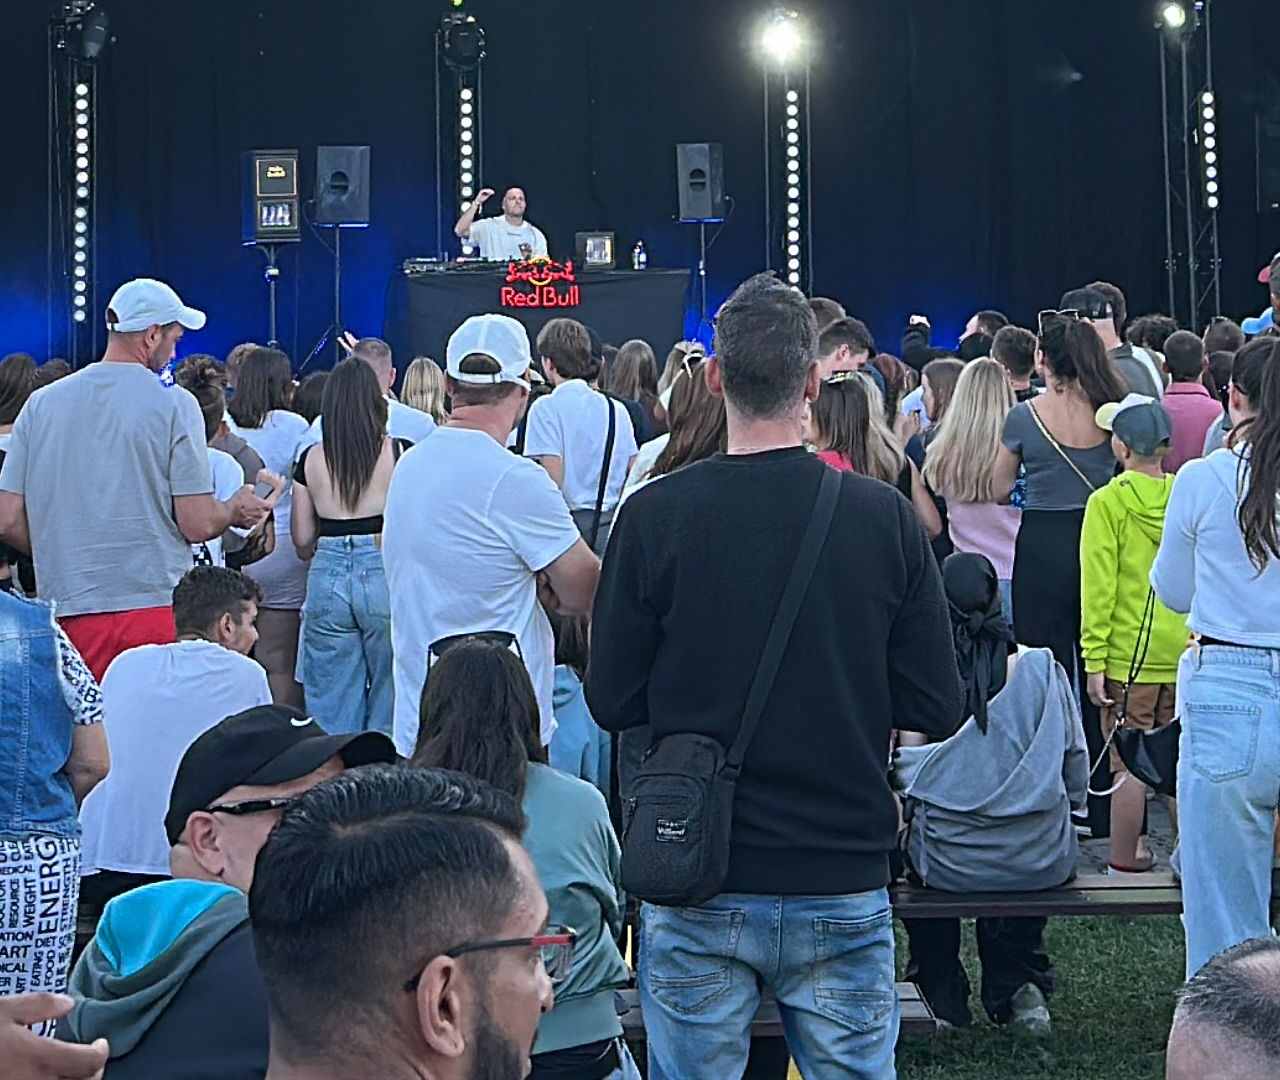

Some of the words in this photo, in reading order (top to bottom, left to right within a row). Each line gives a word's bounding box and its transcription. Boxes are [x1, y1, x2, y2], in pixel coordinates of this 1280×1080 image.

[500, 286, 540, 307] Red
[543, 285, 580, 307] Bull
[22, 877, 37, 928] WEIGHT
[43, 949, 56, 987] FOOD
